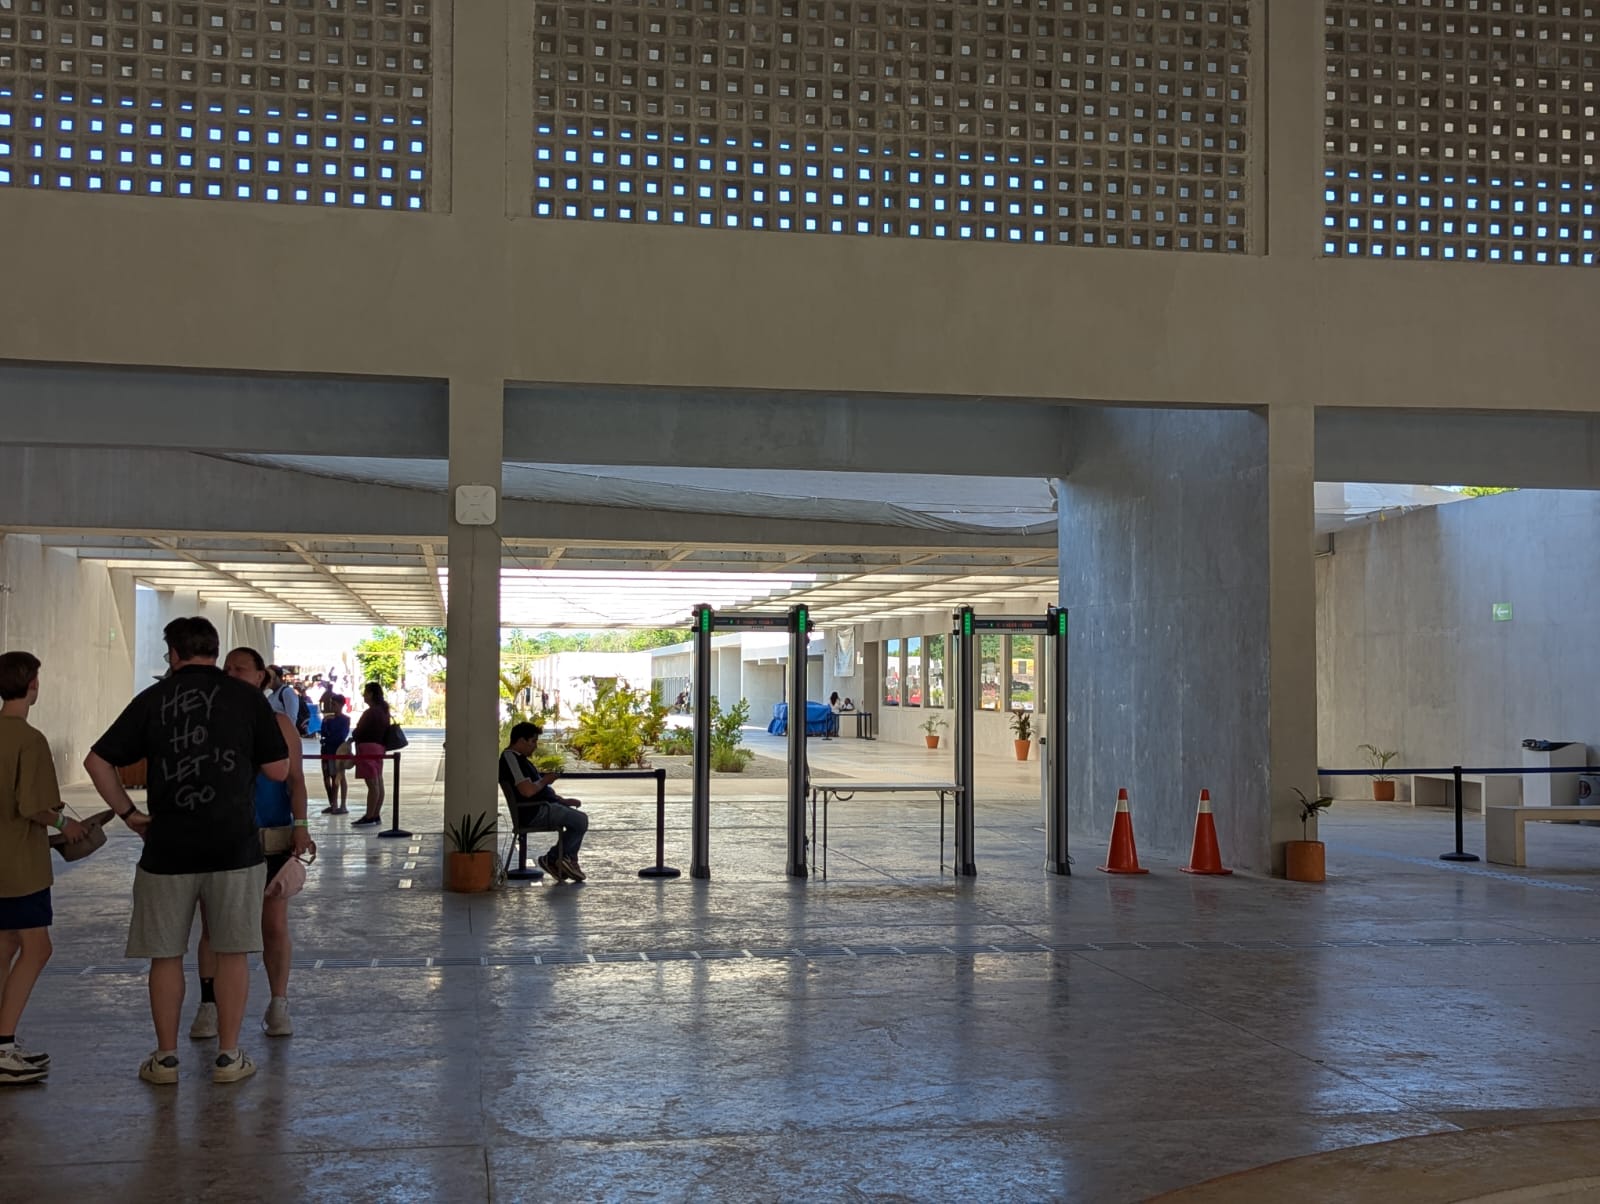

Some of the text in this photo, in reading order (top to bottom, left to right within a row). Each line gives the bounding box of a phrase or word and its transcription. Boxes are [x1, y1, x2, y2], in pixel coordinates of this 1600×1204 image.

[161, 684, 220, 725] HEY
[169, 715, 208, 753] HO
[162, 747, 235, 782] LET'S
[175, 785, 216, 810] GO
